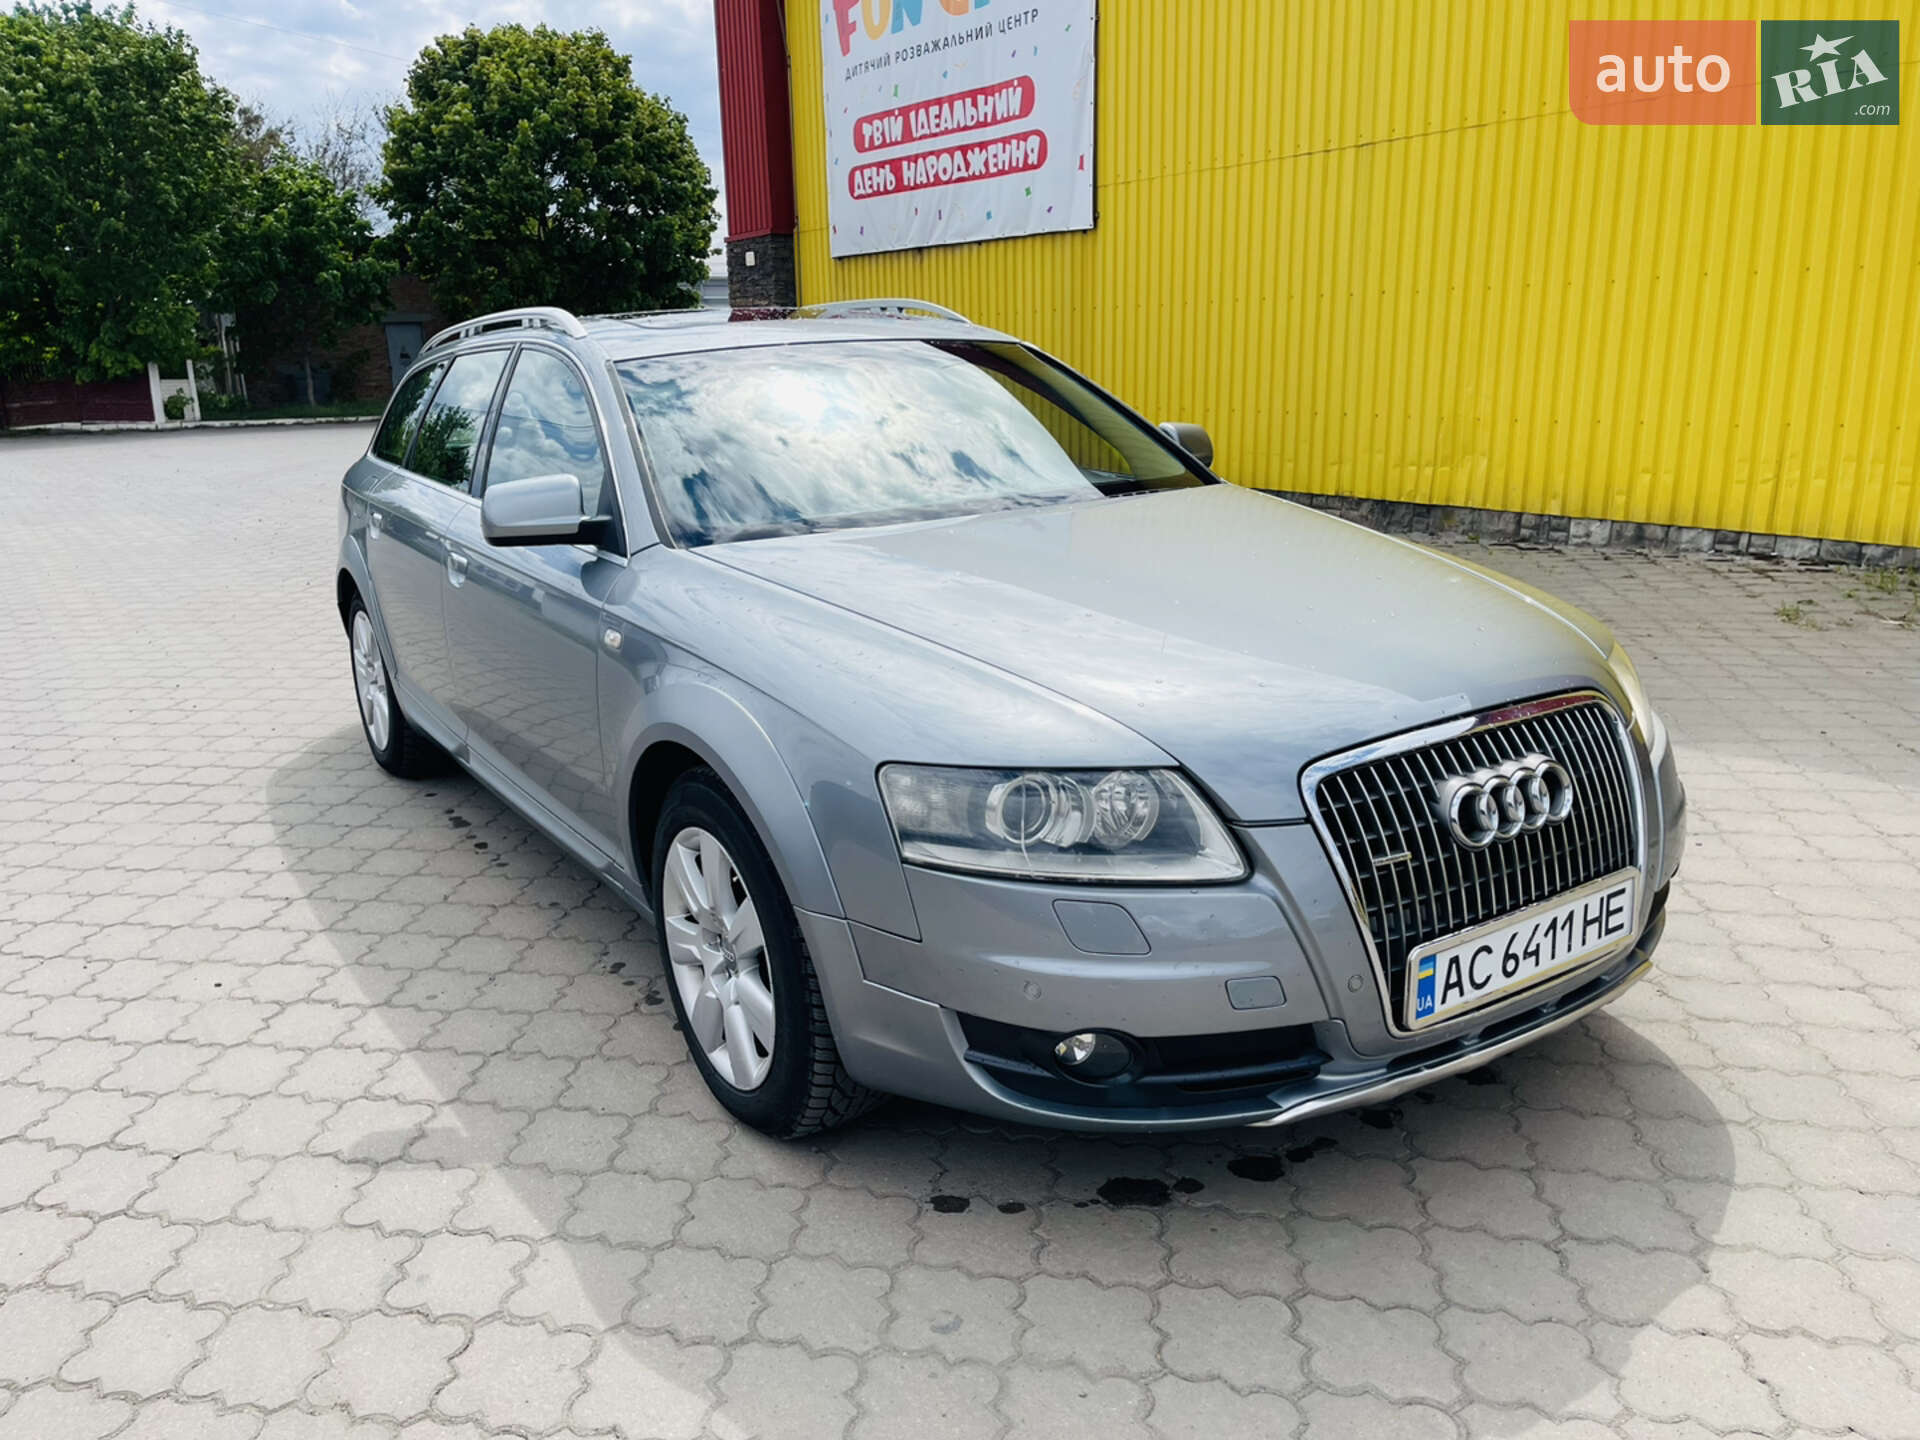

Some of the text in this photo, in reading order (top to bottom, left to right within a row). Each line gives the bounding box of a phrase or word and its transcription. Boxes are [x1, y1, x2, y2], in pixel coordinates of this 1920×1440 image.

[845, 53, 892, 82] ДИТЯЧИЙ
[895, 22, 993, 63] РОЗВАЖАЛЬНИЙ
[998, 8, 1039, 34] ЦЕНТР
[862, 79, 1023, 149] ТВІЙ ІДЕАЛЬНИЙ
[853, 135, 1041, 198] ДЕНЬ НАРОДЖЕННЯ
[1441, 887, 1627, 1005] AC 6411 HE
[1417, 994, 1433, 1012] UA
